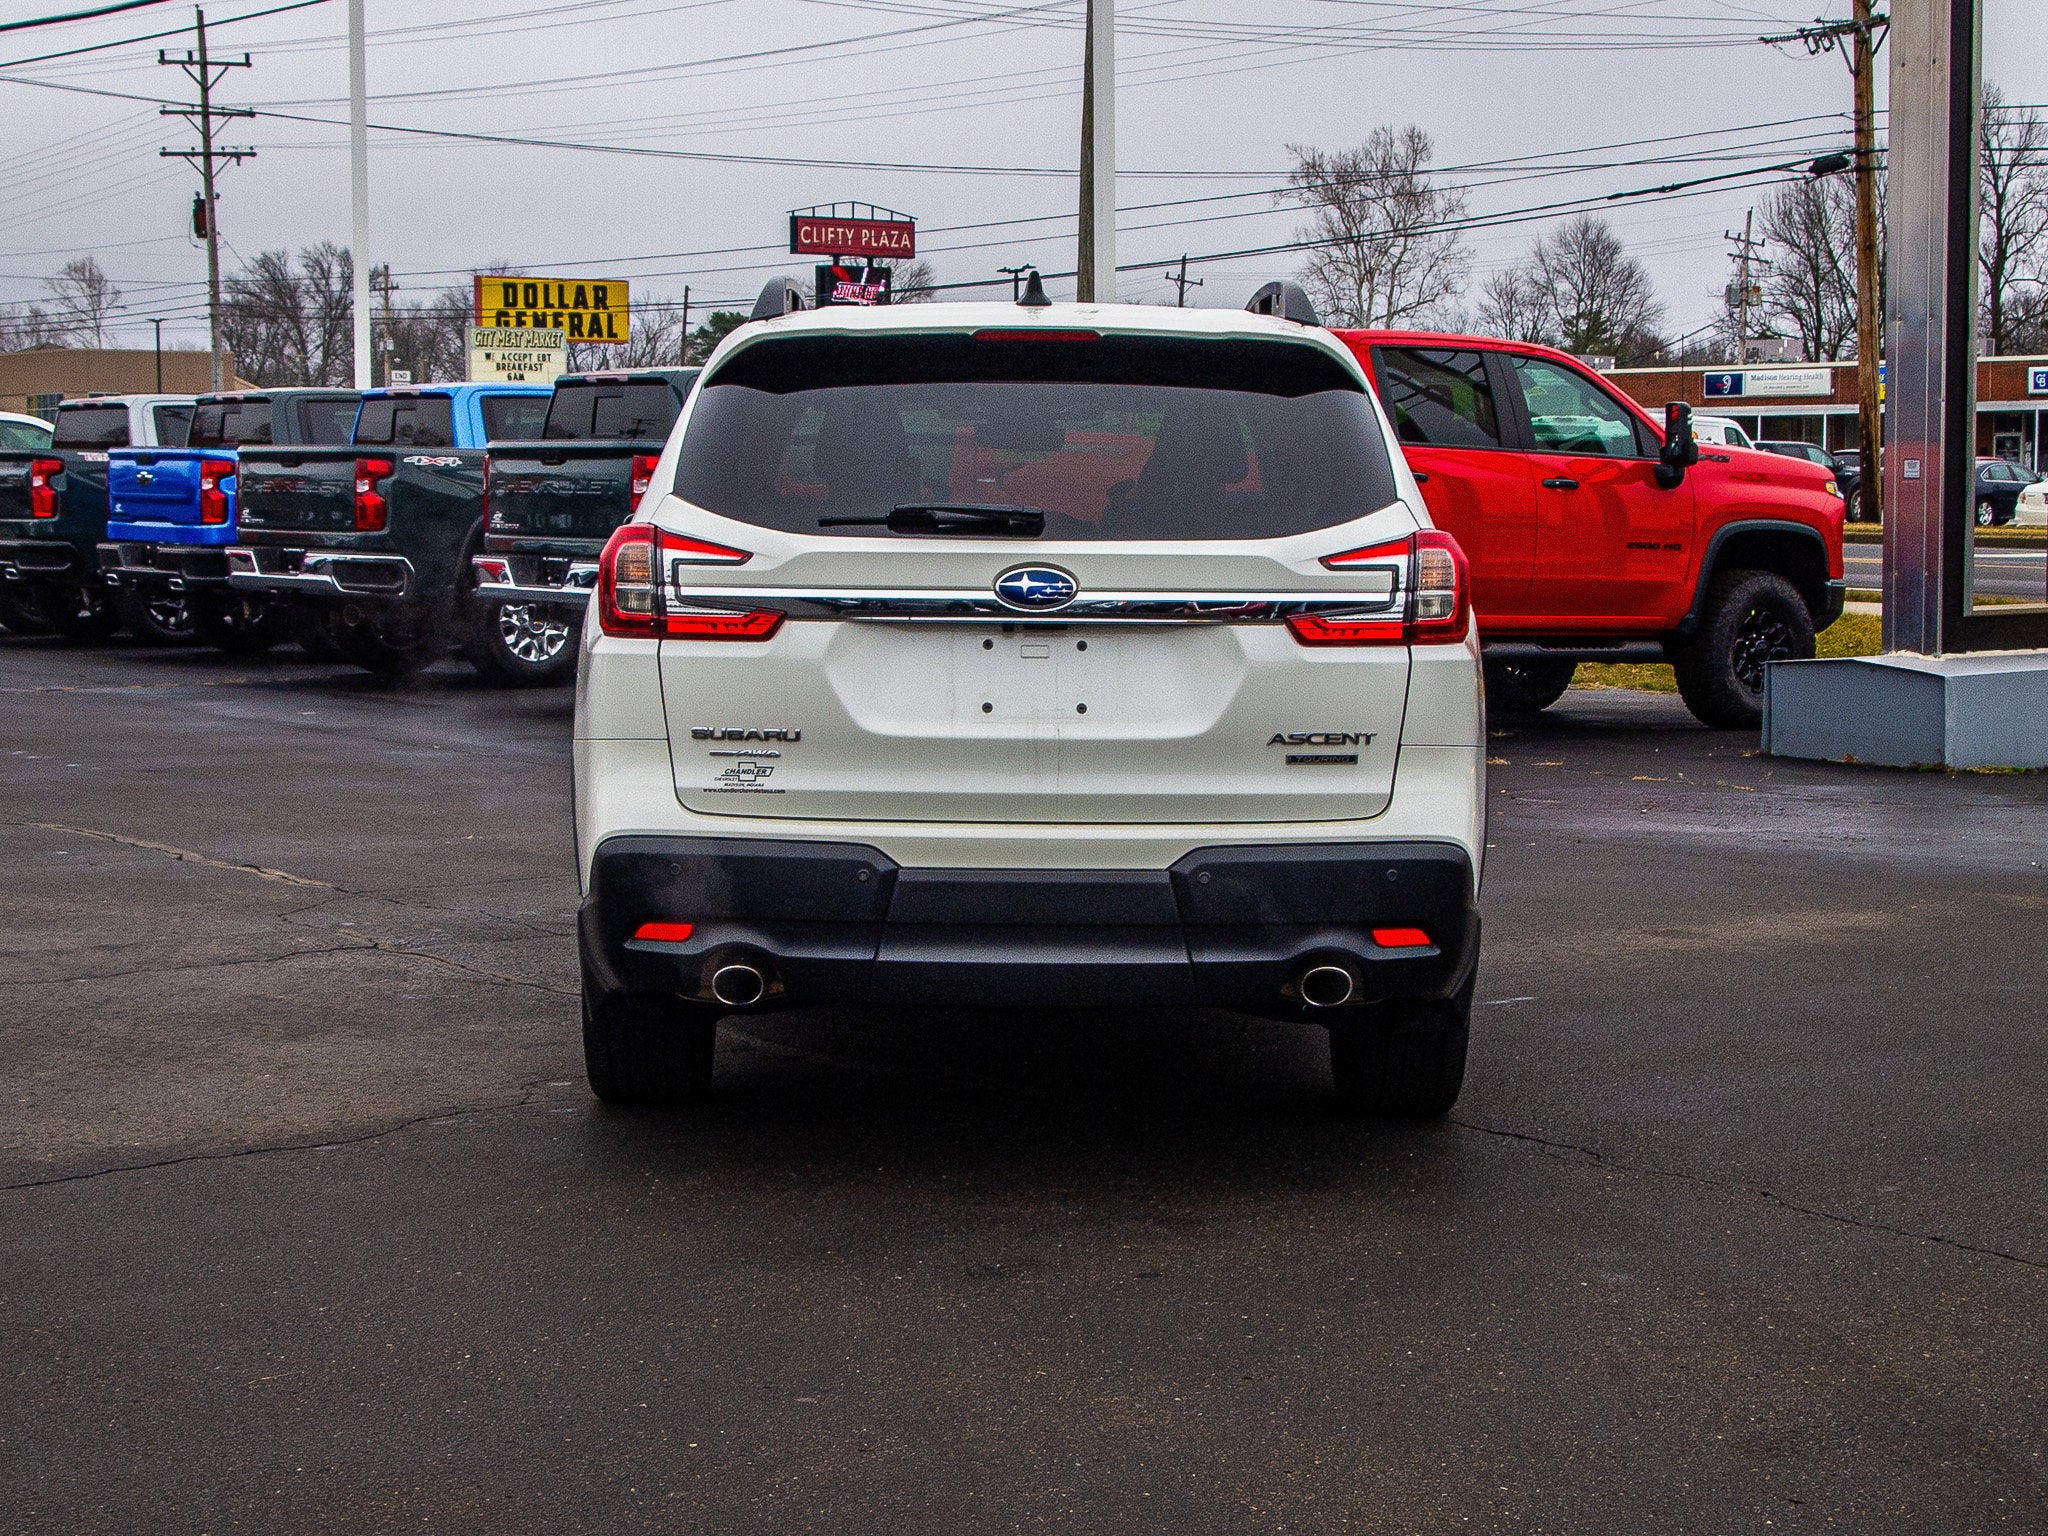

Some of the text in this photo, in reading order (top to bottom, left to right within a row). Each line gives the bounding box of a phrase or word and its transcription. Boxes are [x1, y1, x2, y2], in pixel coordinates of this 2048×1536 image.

[800, 226, 911, 248] CLIFTY PLAZA
[502, 282, 609, 310] DOLLAR
[495, 310, 618, 338] GENERAL
[473, 329, 563, 349] CITY MEAT MARKET
[484, 352, 551, 362] WE ACCEPT EBT
[496, 362, 543, 372] BREAKFAST
[507, 372, 525, 381] 6AM
[1778, 373, 1803, 382] Hearing
[1804, 371, 1824, 380] Health
[690, 726, 801, 742] SUBARU
[1266, 731, 1378, 746] ASCENT
[738, 749, 781, 758] AWD
